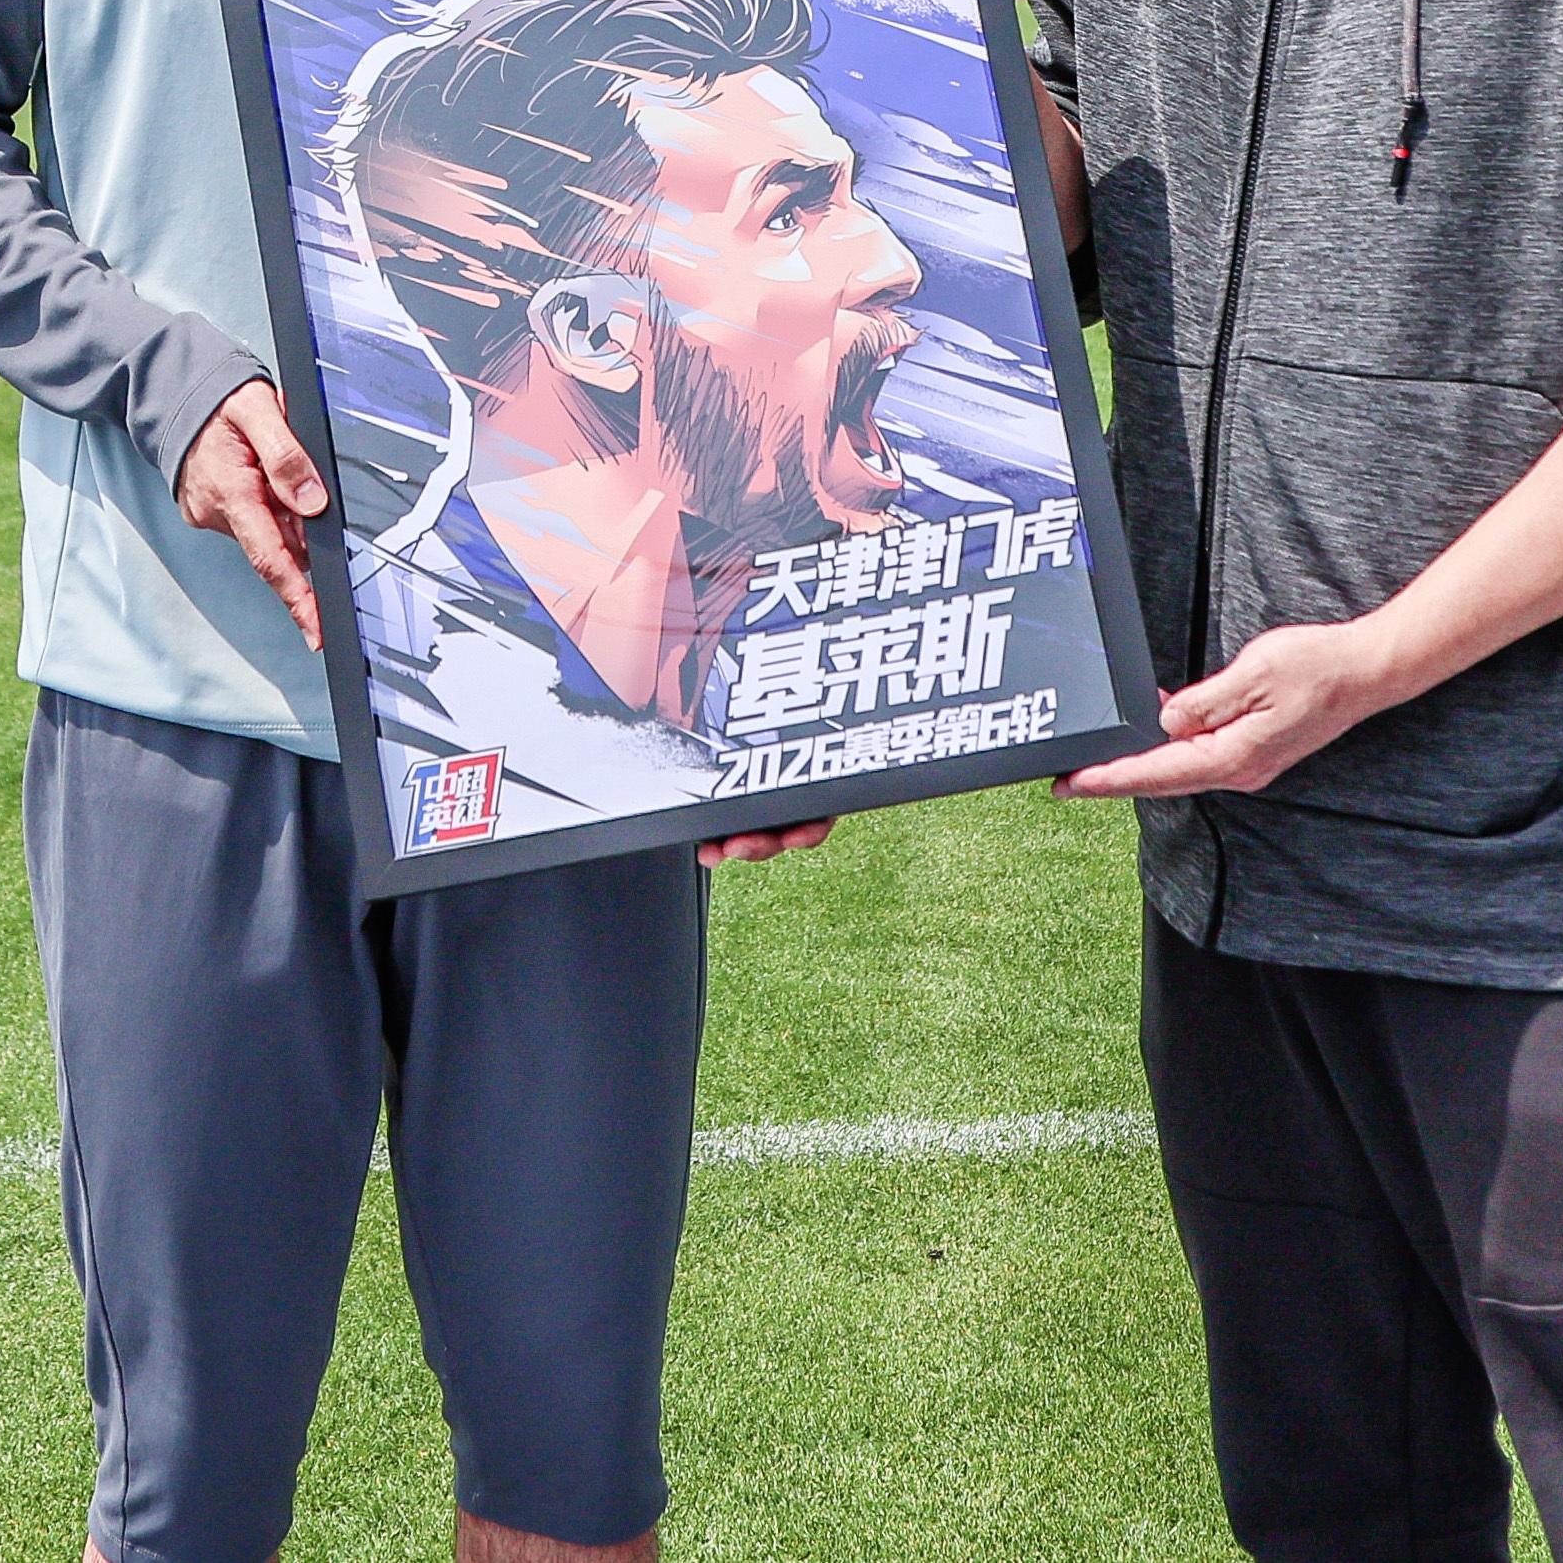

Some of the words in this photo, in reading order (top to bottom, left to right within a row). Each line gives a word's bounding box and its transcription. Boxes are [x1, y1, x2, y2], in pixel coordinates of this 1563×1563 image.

[744, 496, 1079, 626] 天津津门虎
[725, 586, 1016, 737] 基莱斯
[422, 762, 488, 803] 中超
[712, 687, 1058, 800] 2026赛季第6轮
[418, 794, 486, 836] 英雄
